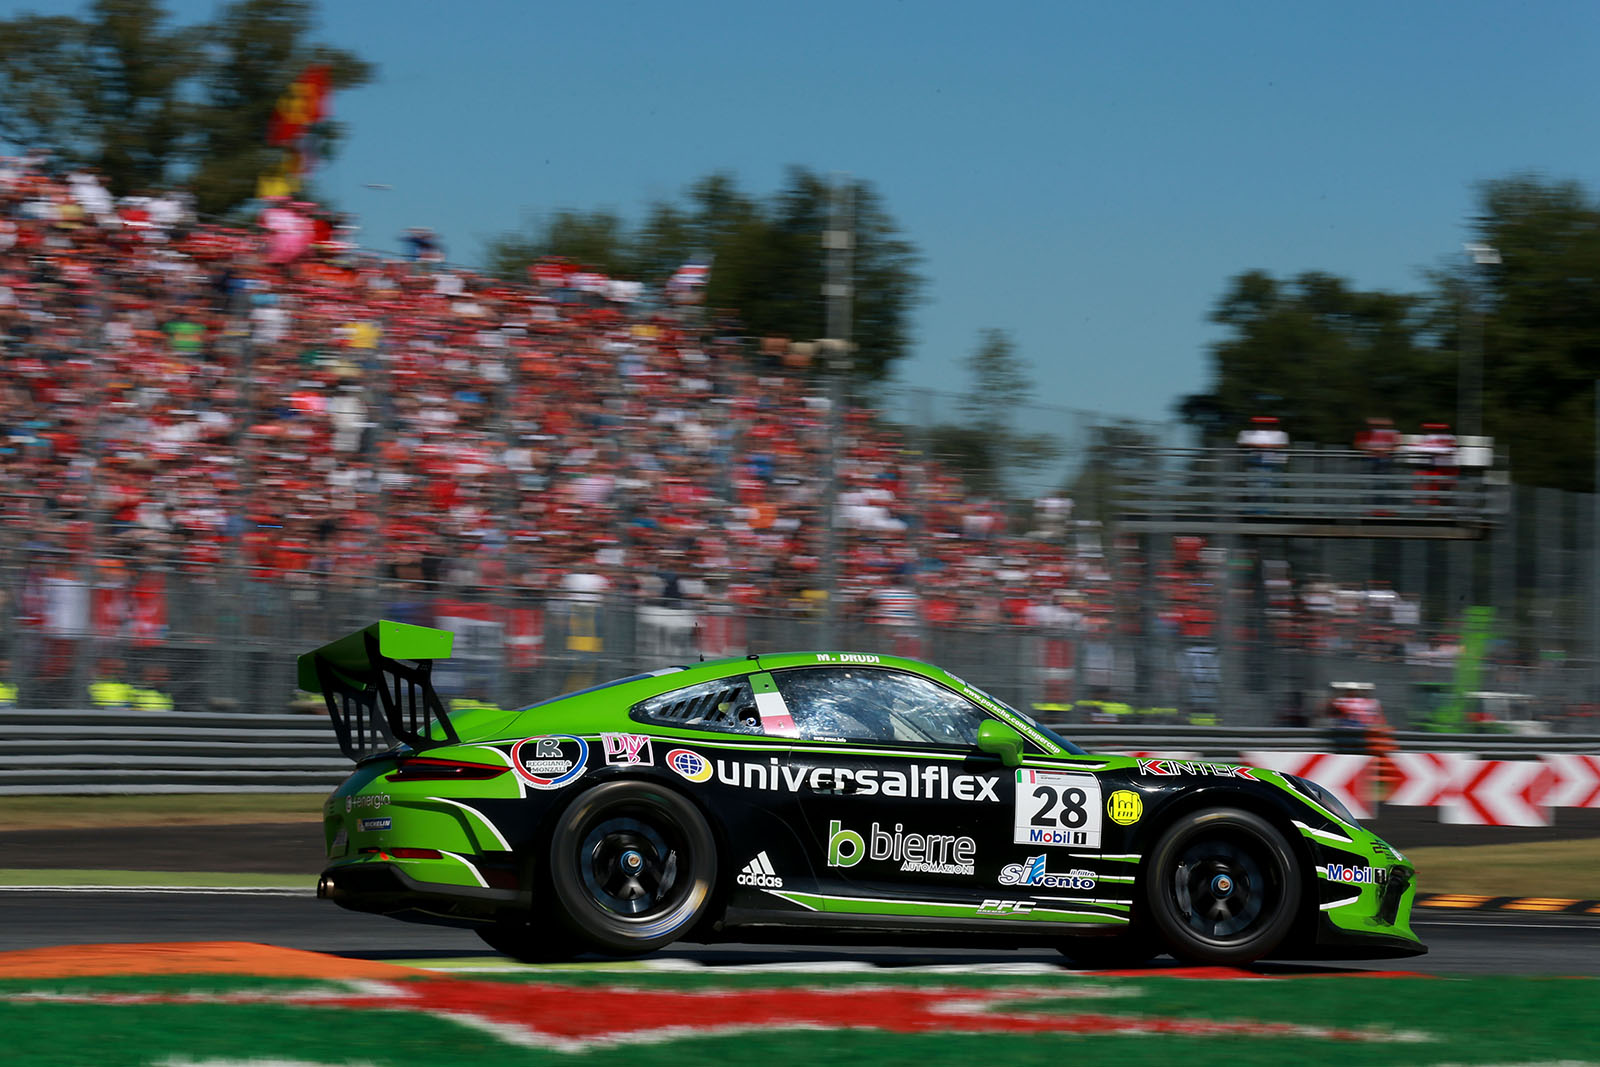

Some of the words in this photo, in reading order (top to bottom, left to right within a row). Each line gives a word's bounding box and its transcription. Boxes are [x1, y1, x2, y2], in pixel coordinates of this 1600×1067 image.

[840, 654, 880, 663] DRUDI
[963, 687, 1060, 753] www.porsche.com/supercup
[717, 757, 1000, 802] universalflex
[1136, 759, 1260, 782] KINTEK
[1031, 786, 1087, 828] 28
[870, 822, 976, 865] bierre
[1030, 829, 1070, 843] Mobil
[901, 861, 975, 875] AUTOMAZIONI
[1328, 864, 1372, 883] Mobil
[737, 873, 783, 888] adidas
[980, 899, 1036, 912] PFC
